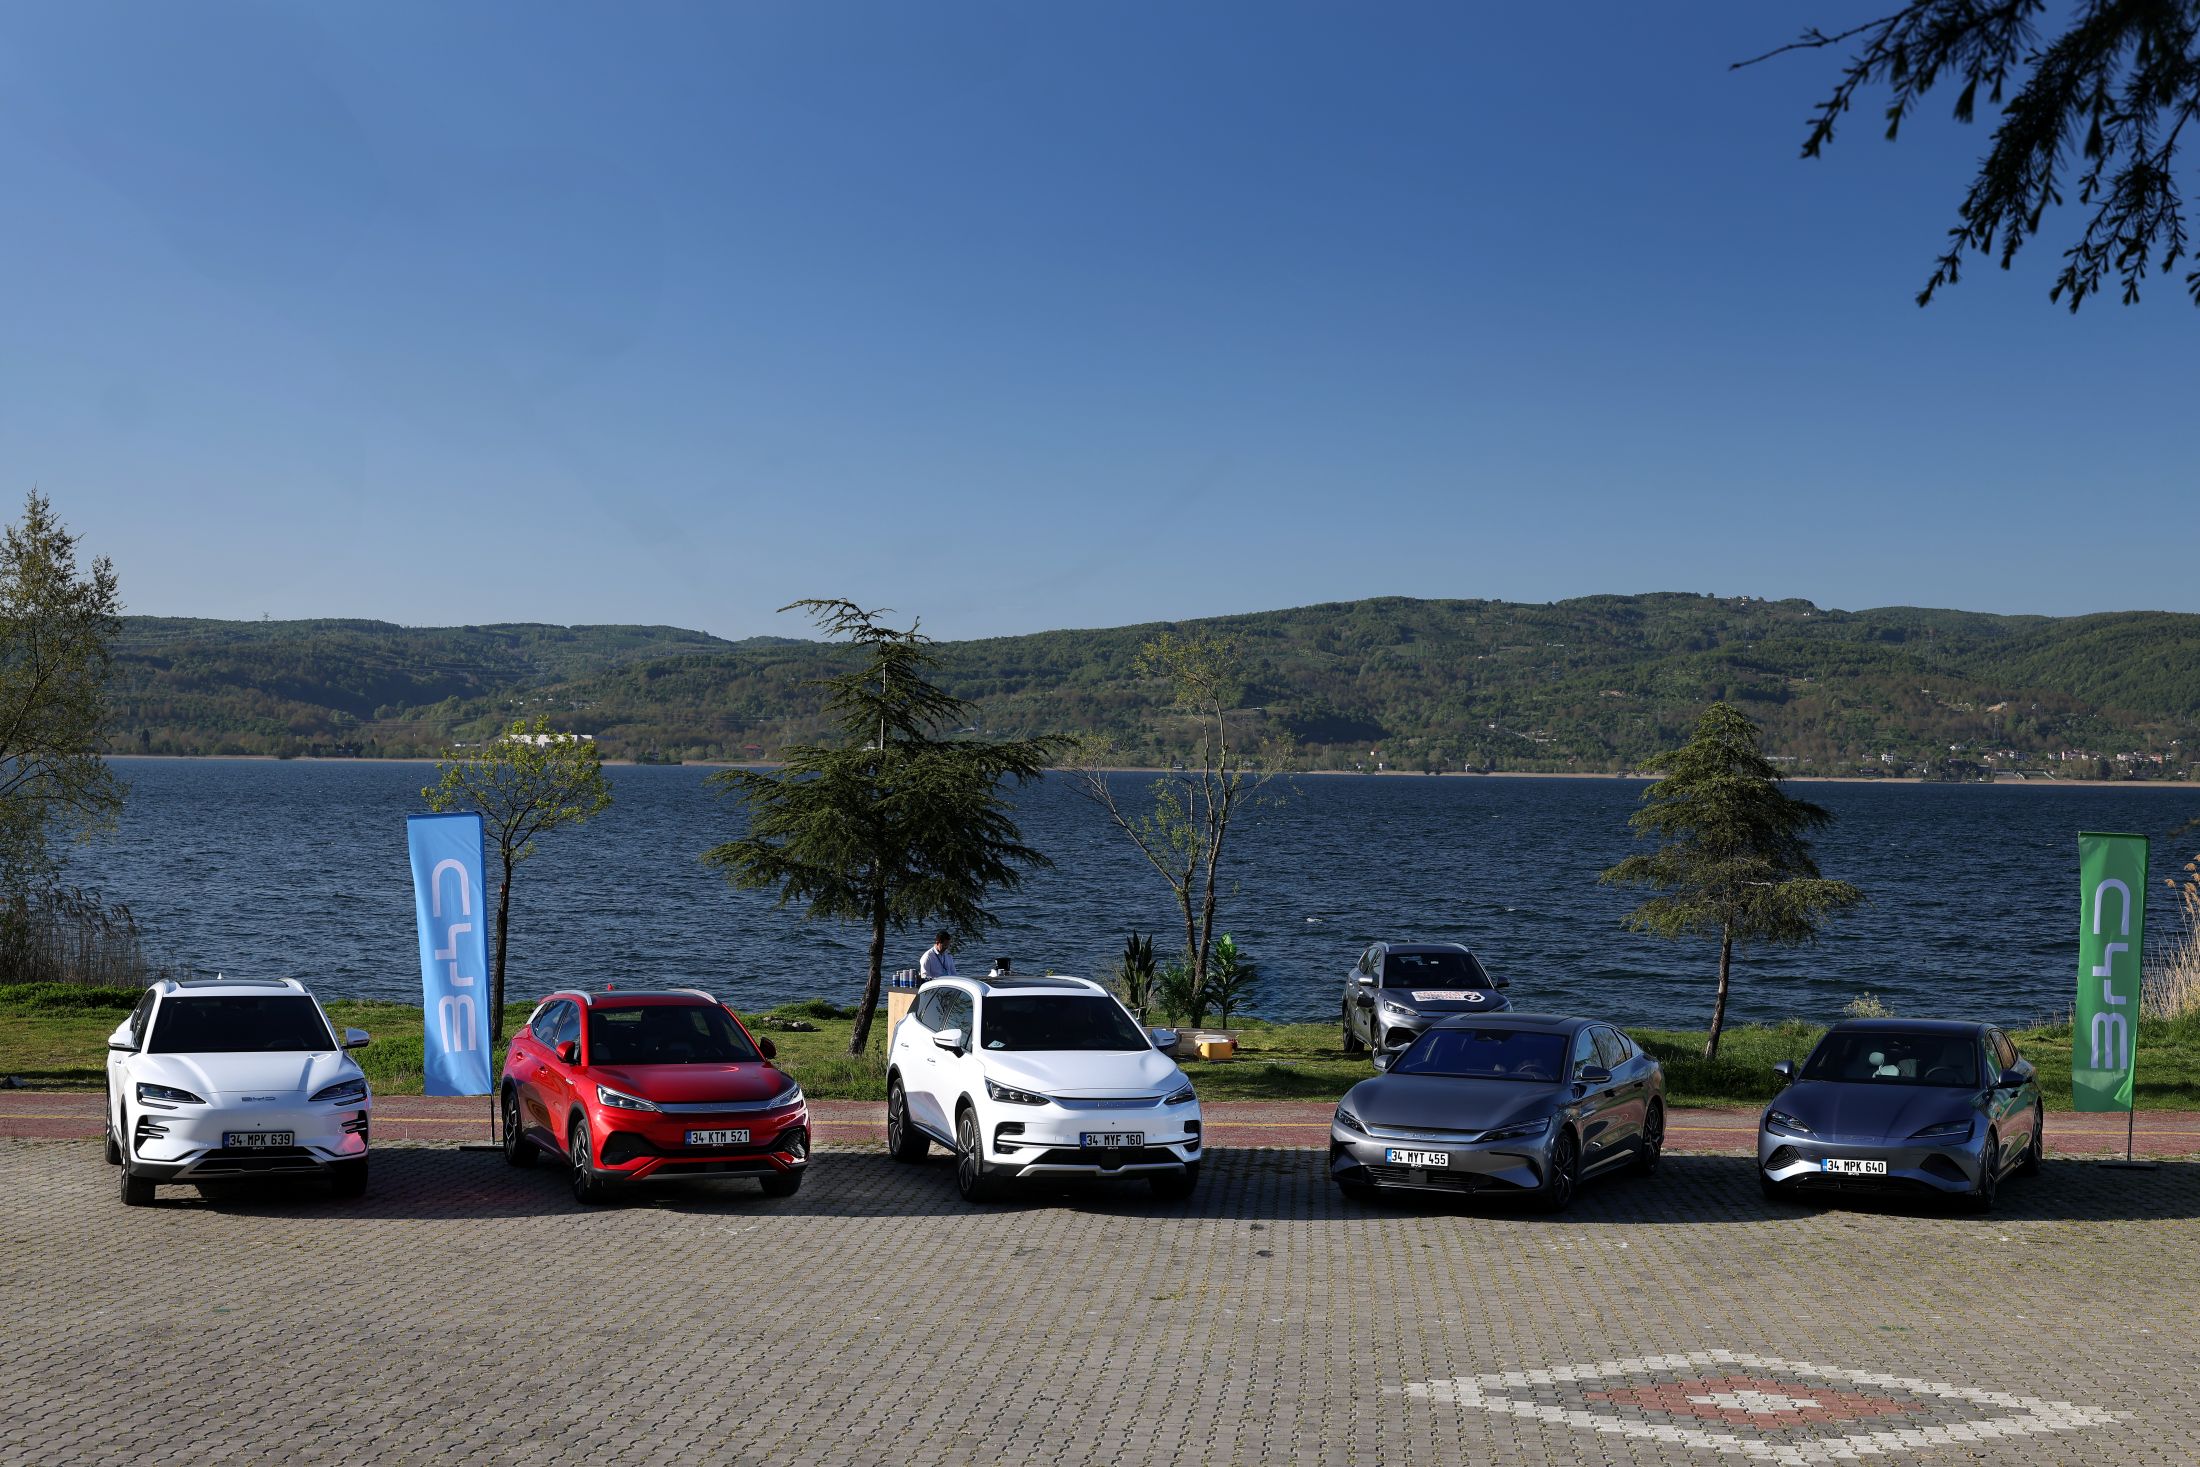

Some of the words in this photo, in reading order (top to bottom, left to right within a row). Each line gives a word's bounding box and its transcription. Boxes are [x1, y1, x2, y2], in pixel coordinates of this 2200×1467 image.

[229, 1134, 242, 1146] 34
[247, 1134, 266, 1146] MPK
[271, 1133, 290, 1145] 639
[692, 1132, 704, 1144] 34
[708, 1131, 726, 1143] KTM
[730, 1130, 748, 1142] 521
[1086, 1135, 1098, 1146] 34
[1104, 1134, 1121, 1146] MYF
[1126, 1134, 1141, 1145] 160
[1391, 1150, 1402, 1162] 34
[1407, 1152, 1424, 1163] MYT
[1428, 1153, 1446, 1165] 455
[1827, 1160, 1839, 1171] 34
[1844, 1160, 1861, 1172] MPK
[1865, 1162, 1884, 1173] 640
